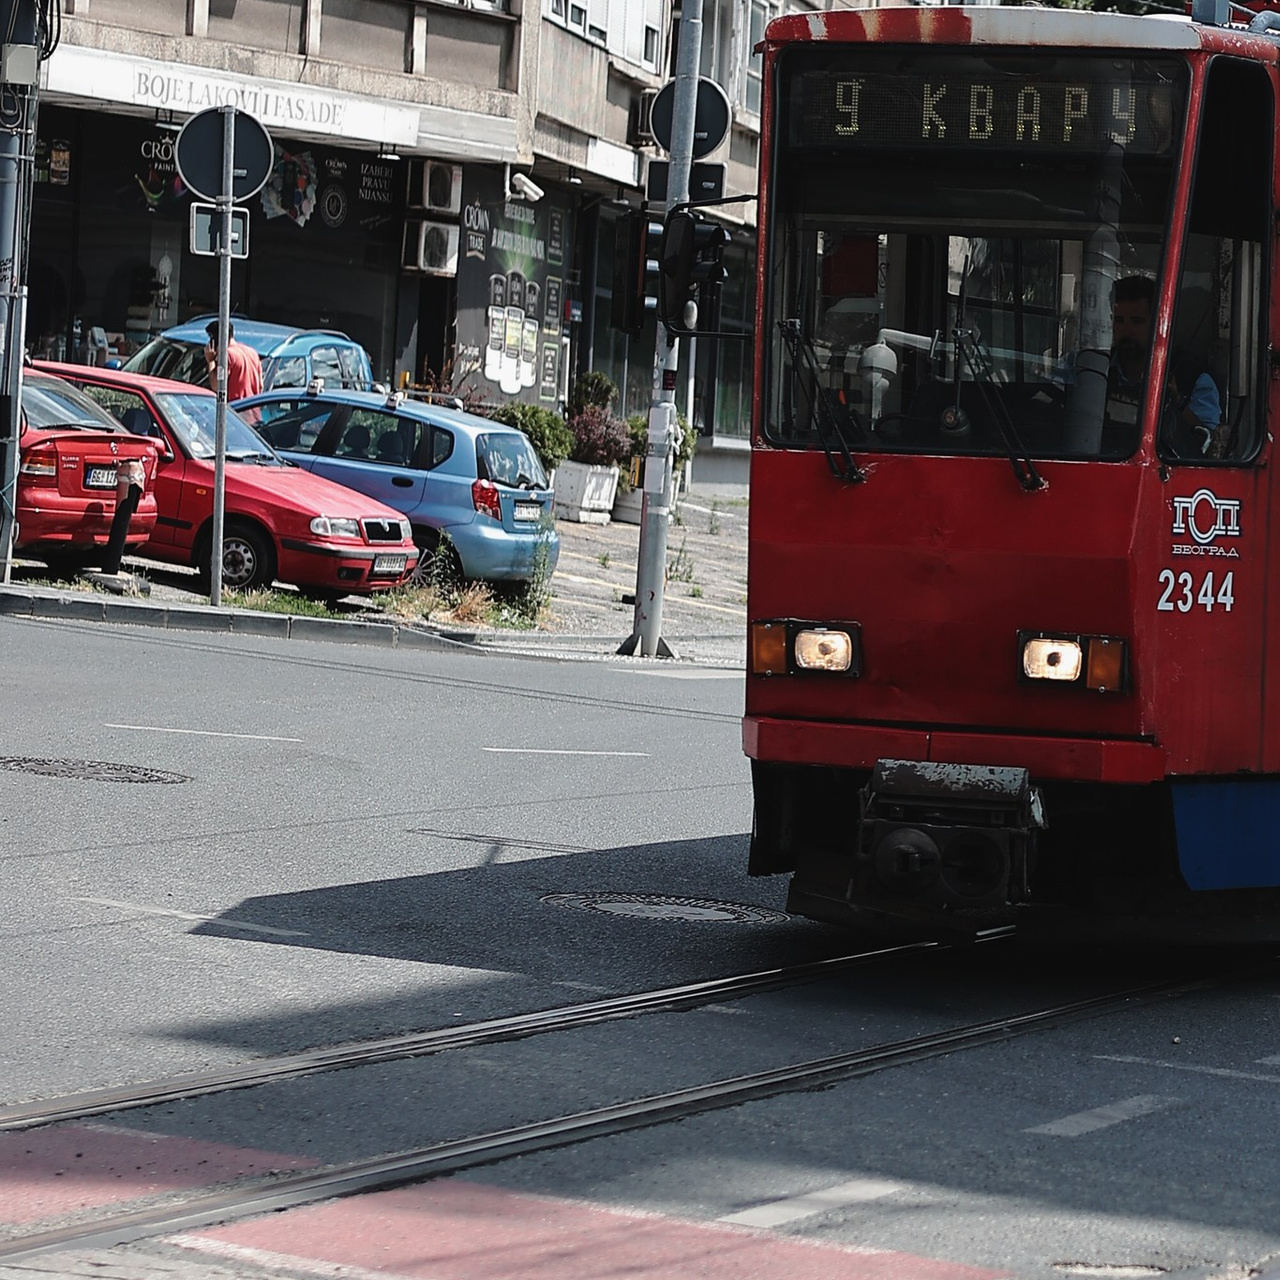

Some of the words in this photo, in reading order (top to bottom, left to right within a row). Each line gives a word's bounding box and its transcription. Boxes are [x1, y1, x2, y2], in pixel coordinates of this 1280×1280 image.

[137, 72, 184, 105] BOJE
[188, 81, 257, 112] LAKOVI
[262, 93, 270, 116] I
[274, 94, 343, 127] FASADE
[835, 80, 860, 136] 9
[361, 163, 393, 179] IZABERI
[362, 176, 391, 190] PRAVU
[359, 188, 393, 204] NIJANSU
[464, 204, 490, 232] CROWN
[1157, 568, 1235, 613] 2344
